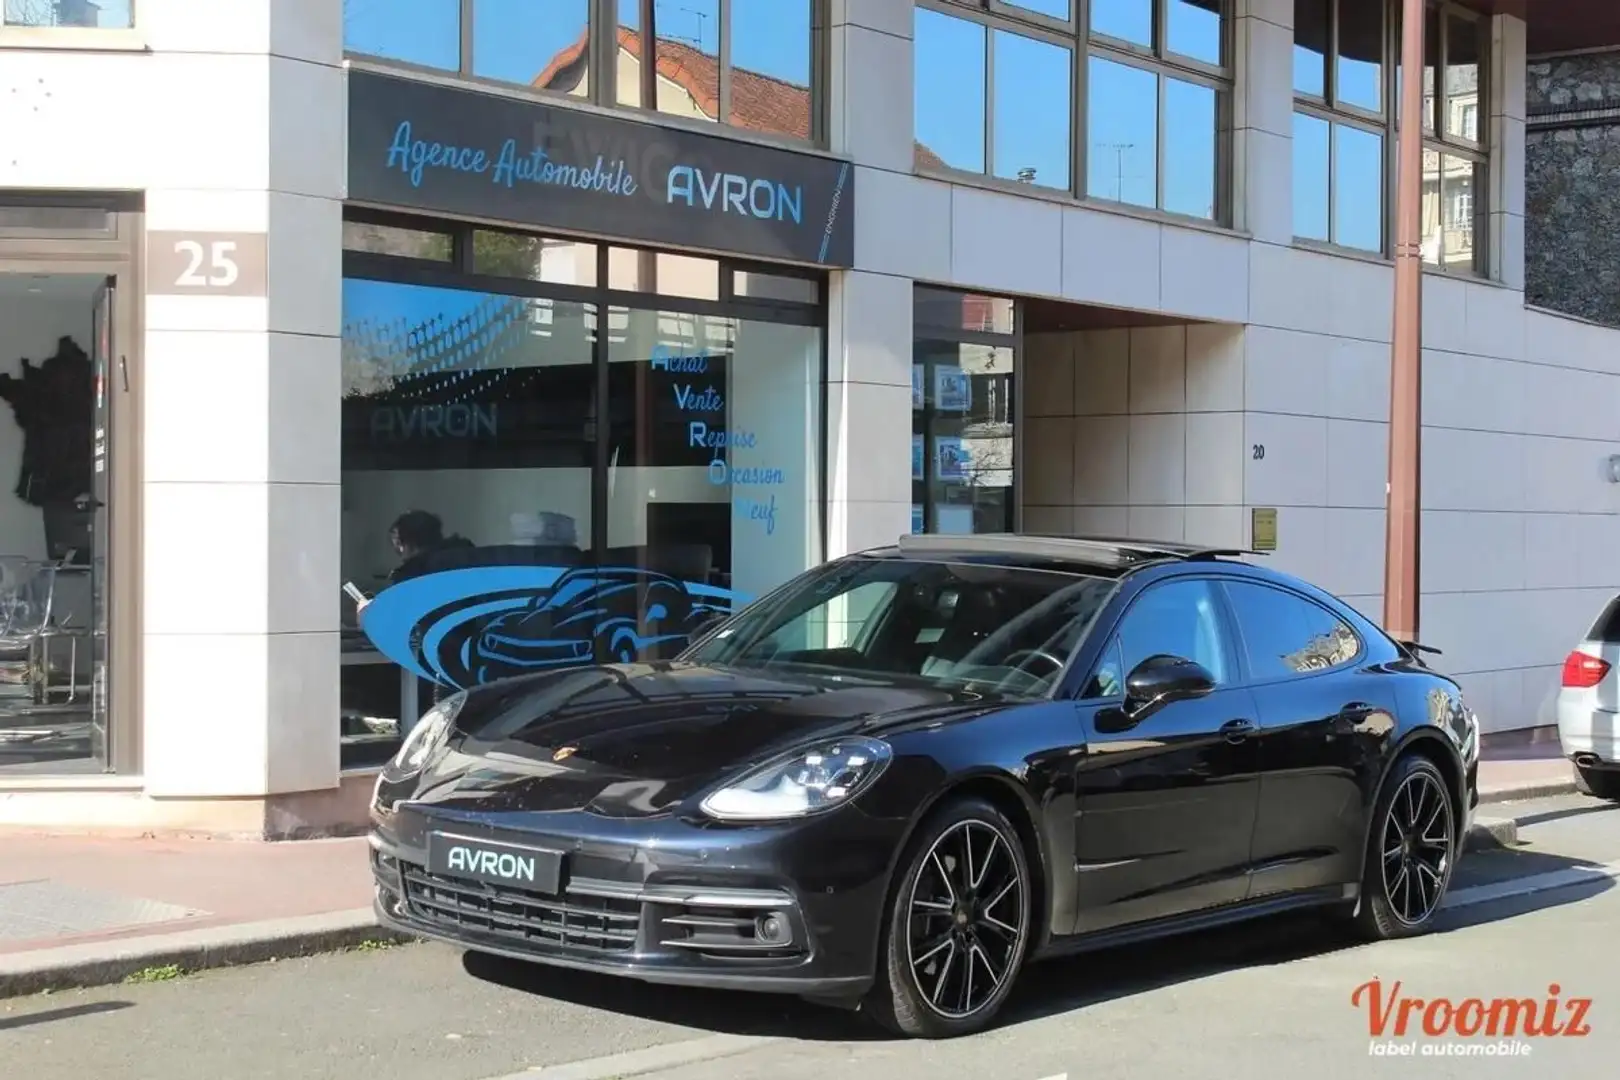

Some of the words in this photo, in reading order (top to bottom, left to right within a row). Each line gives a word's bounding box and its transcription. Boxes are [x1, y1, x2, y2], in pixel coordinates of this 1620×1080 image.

[386, 120, 490, 187] Agence
[492, 138, 637, 196] Automobile
[666, 164, 803, 225] AVRON
[173, 240, 239, 287] 25
[651, 346, 708, 374] Achat
[673, 382, 725, 411] Vente
[370, 403, 498, 440] AVRON
[689, 420, 757, 459] Reprise
[1252, 444, 1265, 460] 20
[708, 458, 785, 486] Occasion
[447, 846, 535, 882] AVRON
